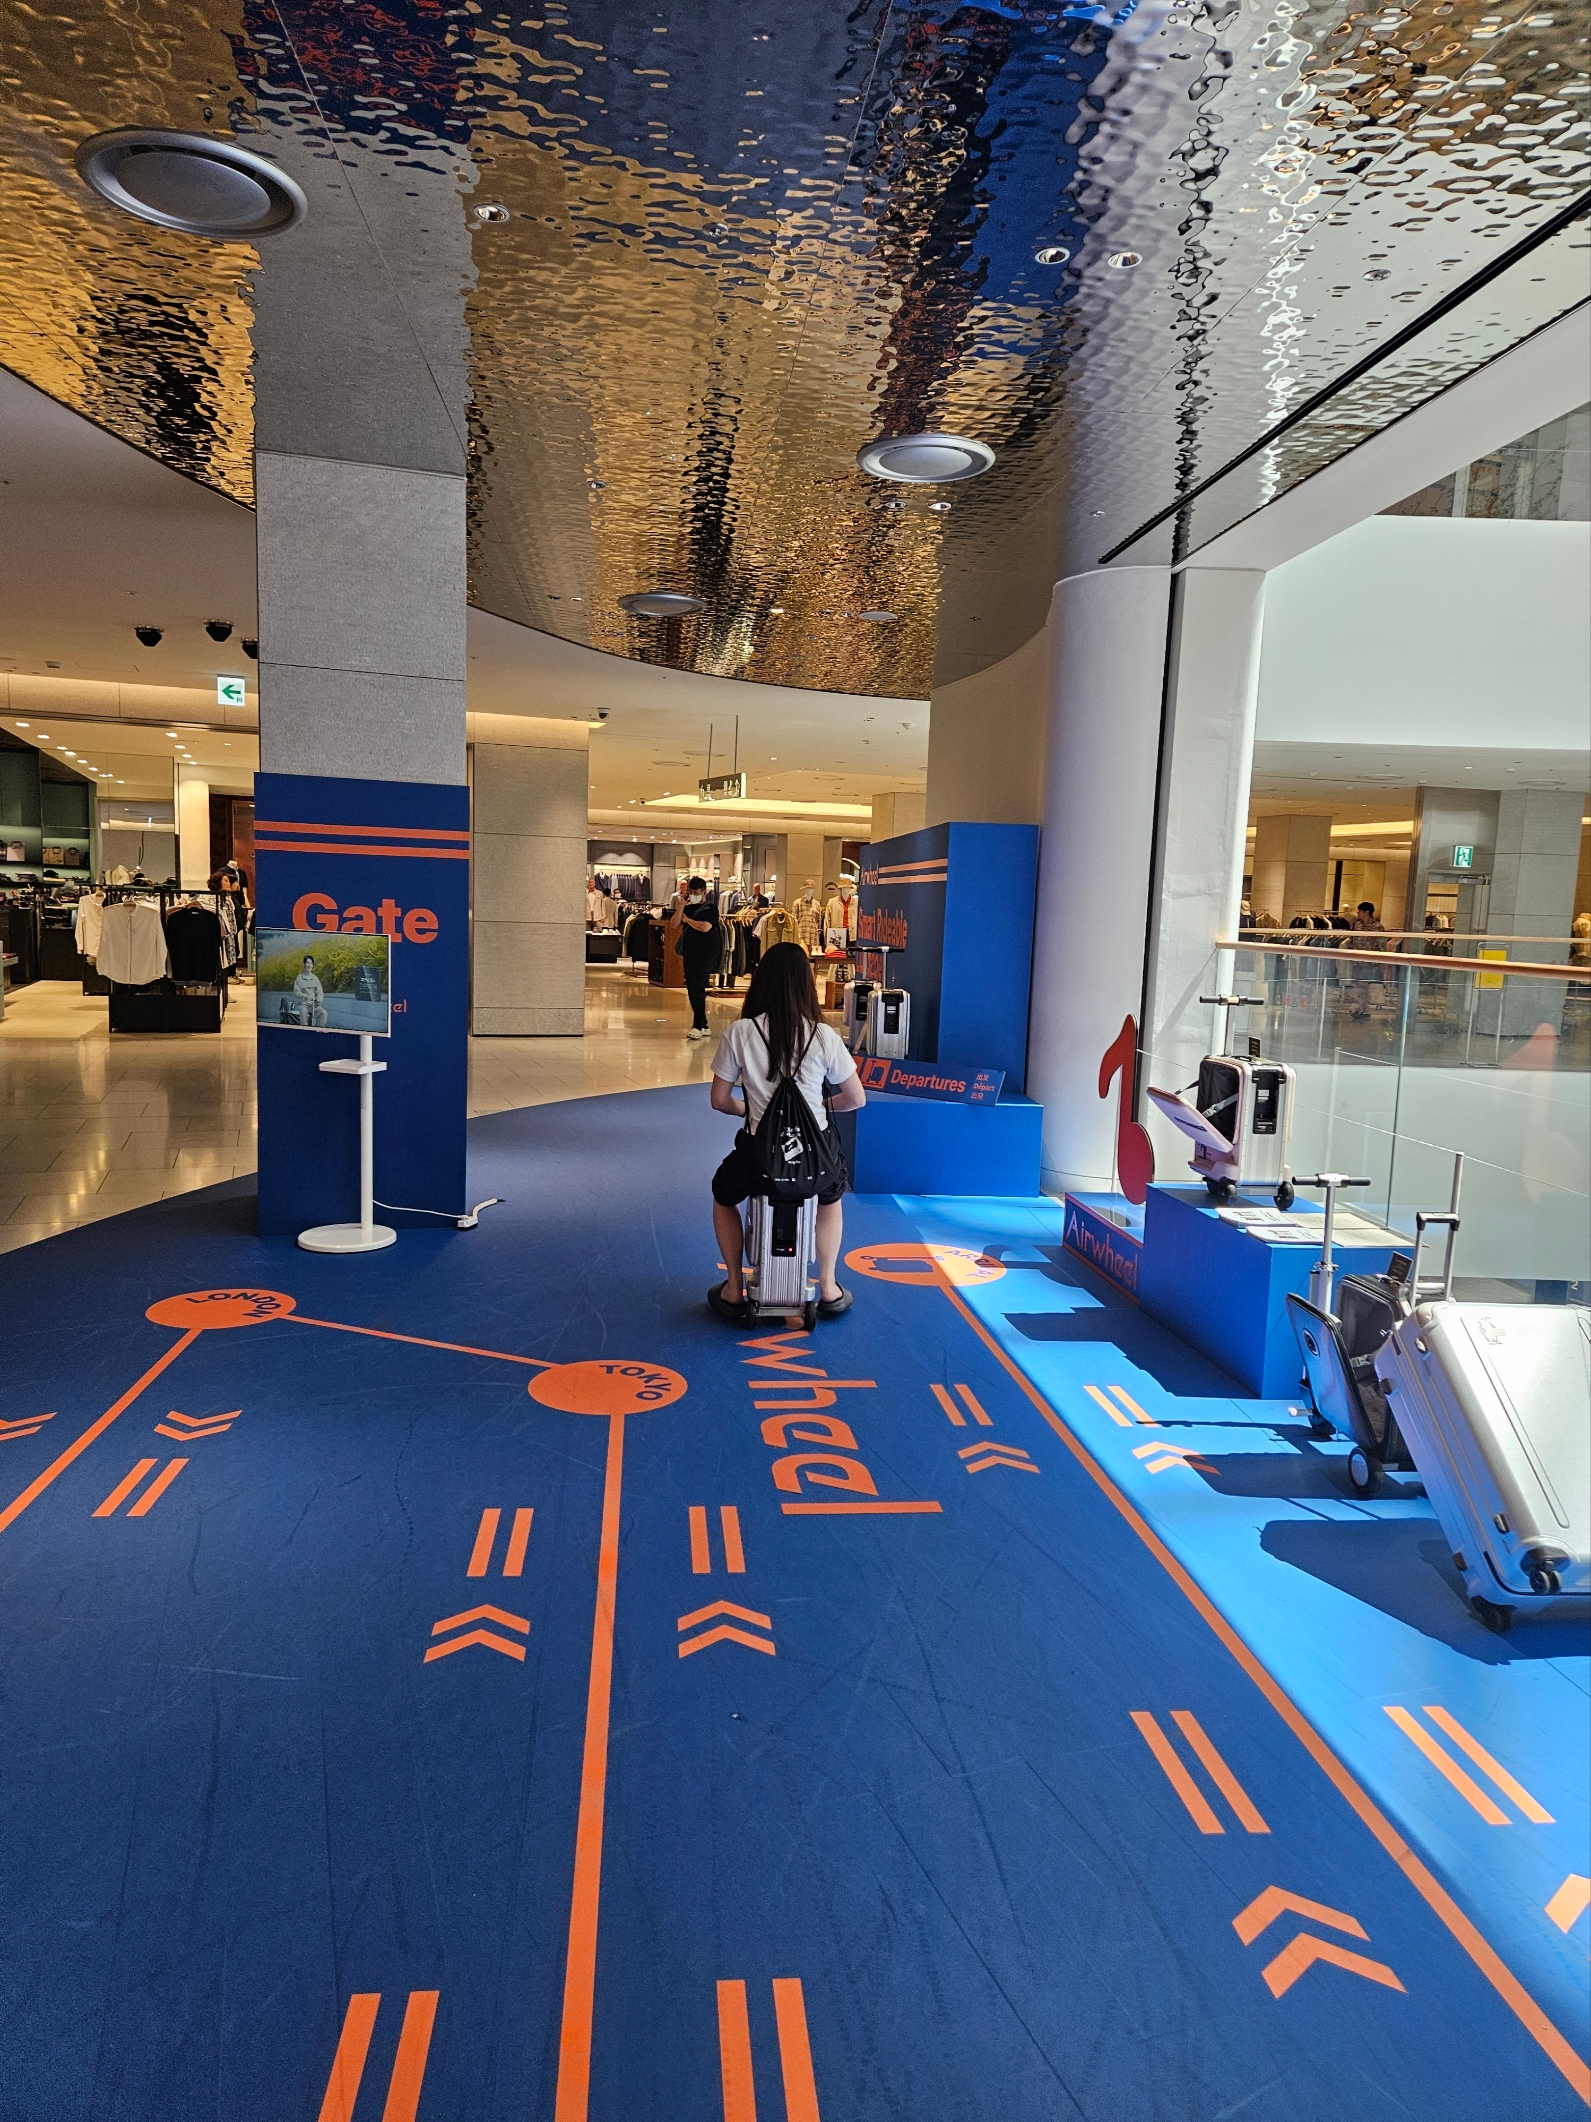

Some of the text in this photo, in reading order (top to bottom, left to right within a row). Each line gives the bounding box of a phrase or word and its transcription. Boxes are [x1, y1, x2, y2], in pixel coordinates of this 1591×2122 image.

[292, 892, 439, 944] Gate
[890, 1069, 966, 1093] Departures
[1066, 1209, 1139, 1291] Airwheel
[185, 1292, 282, 1318] LONDON
[598, 1364, 672, 1401] TOKYO
